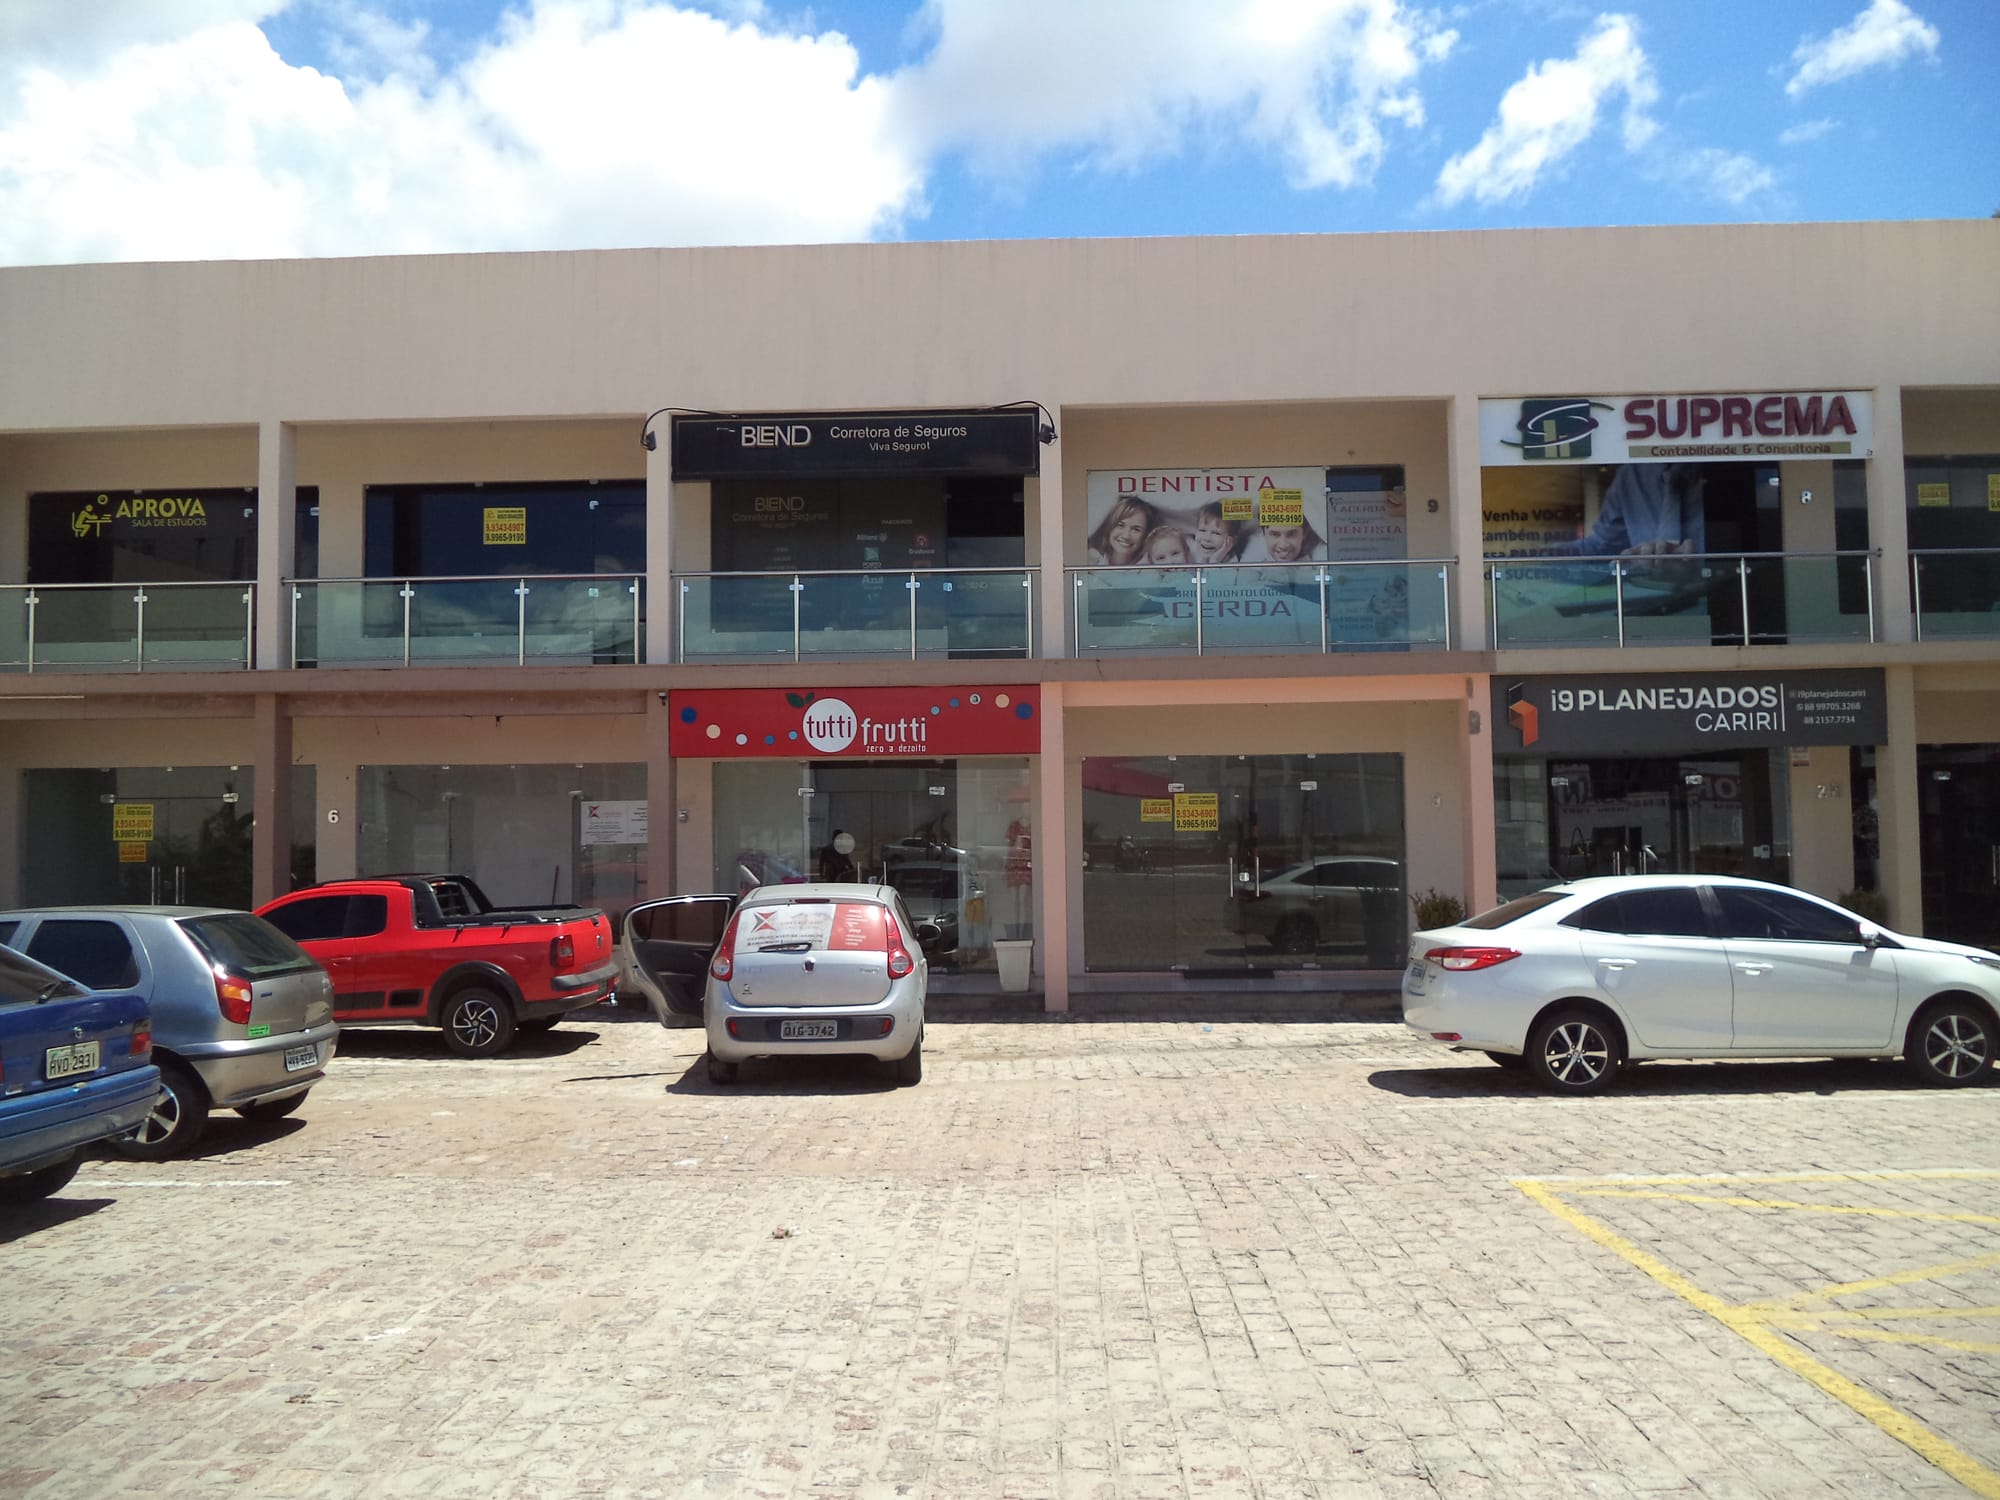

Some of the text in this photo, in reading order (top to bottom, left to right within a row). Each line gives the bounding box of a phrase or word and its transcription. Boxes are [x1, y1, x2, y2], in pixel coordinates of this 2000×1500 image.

[1623, 395, 1857, 440] SUPREMA
[741, 425, 812, 447] BLEND
[830, 424, 967, 440] Corretora de Seguros
[1650, 442, 1831, 457] Contabilidade & Consultoria
[1117, 475, 1277, 493] DENTISTA
[755, 496, 805, 512] BLEND
[1801, 490, 1812, 503] 8
[115, 497, 206, 518] APROVA
[1428, 500, 1439, 512] 9
[131, 517, 207, 528] SALA DE ESTUDOS
[1483, 509, 1529, 522] Venha
[1333, 526, 1403, 535] DENTISTA
[1551, 686, 1778, 712] i9 PLANEJADOS
[806, 714, 851, 738] tutti
[1695, 712, 1777, 732] CARIRI
[861, 716, 927, 746] frutti
[866, 744, 884, 753] zero
[898, 744, 927, 752] dezoito
[328, 809, 339, 824] 6
[1176, 809, 1217, 818] 9.9343-6907
[1176, 819, 1217, 828] 9.9965-9190
